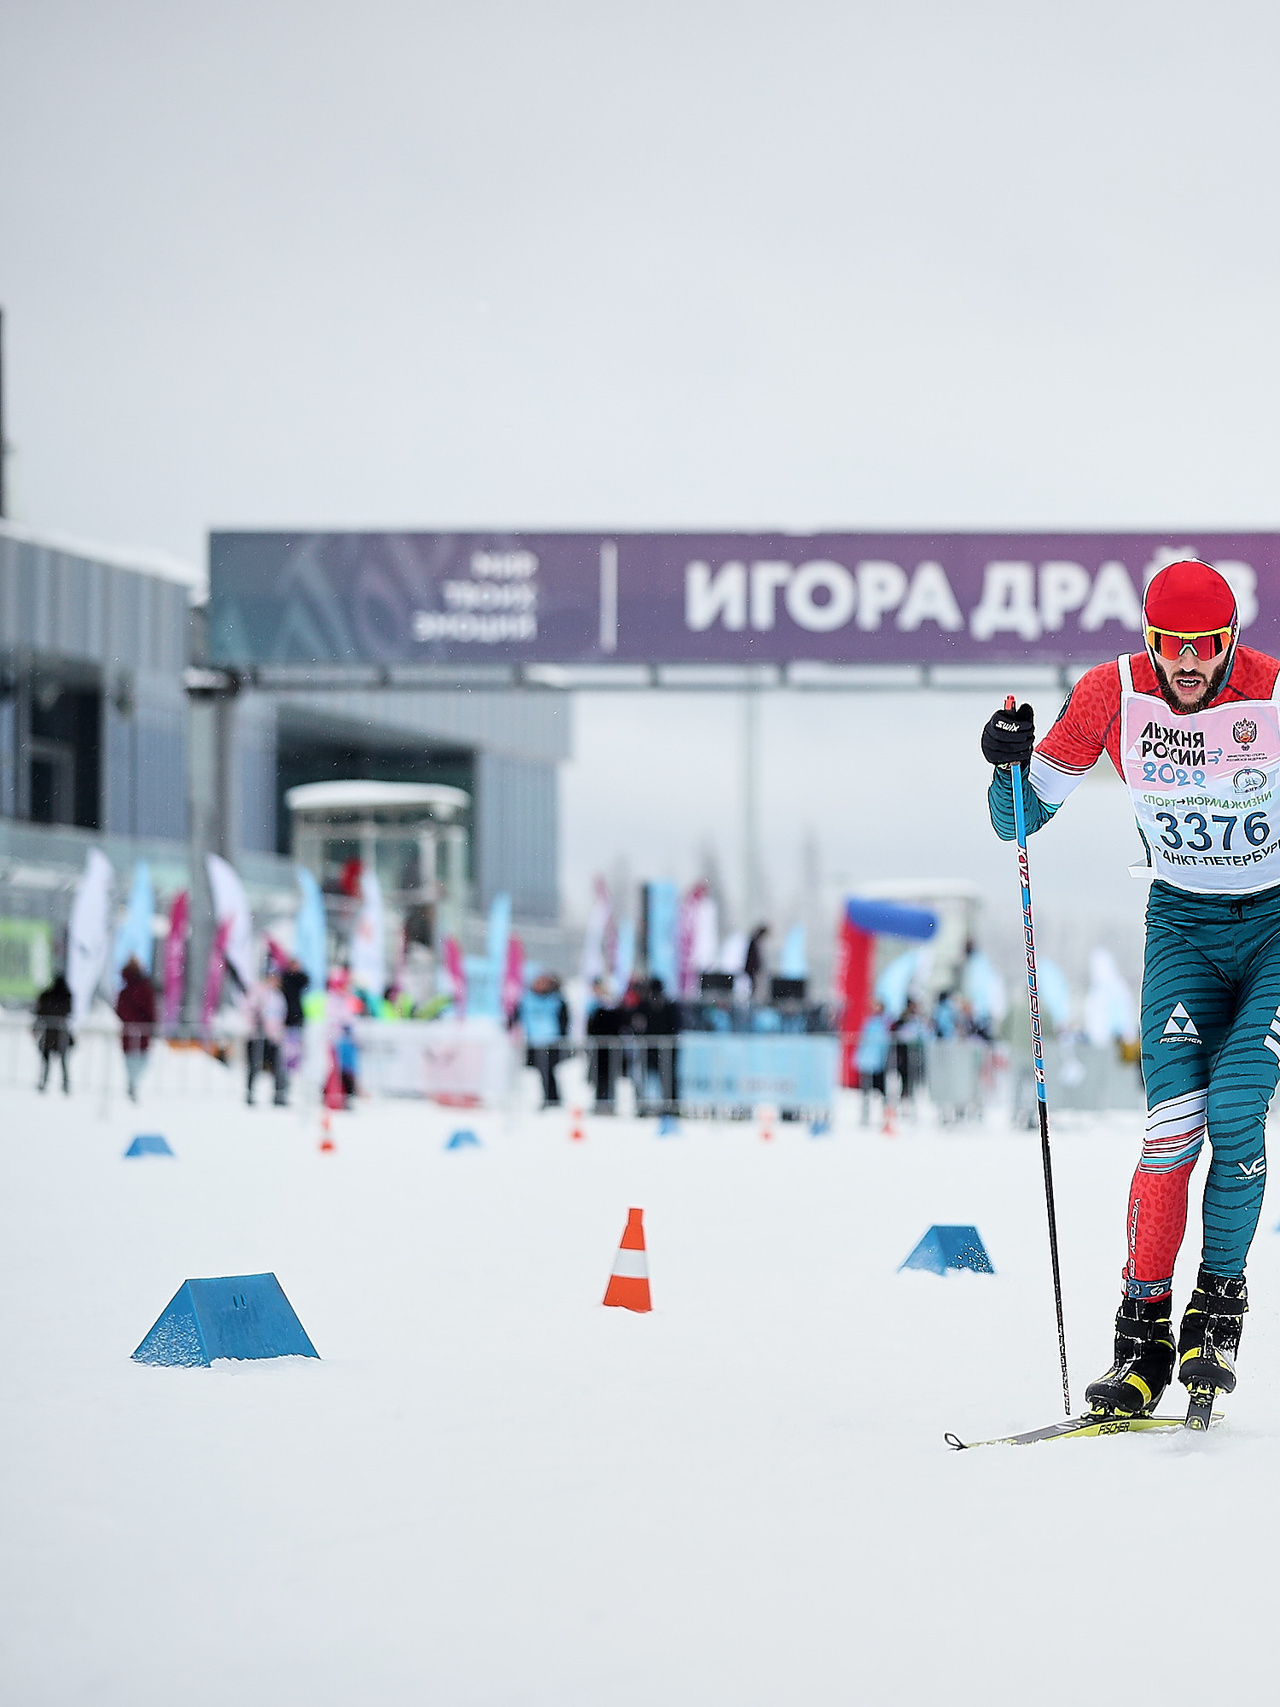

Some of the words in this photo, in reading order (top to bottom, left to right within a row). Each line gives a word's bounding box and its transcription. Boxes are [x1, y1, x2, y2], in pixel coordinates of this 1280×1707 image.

[685, 560, 963, 632] ИГОРА
[971, 547, 1257, 641] ДРА
[1142, 761, 1207, 789] 2022
[1143, 794, 1177, 807] СПОРТ
[1186, 794, 1230, 809] НОРМА
[1230, 790, 1273, 809] ЖИЗНИ
[1155, 811, 1271, 851] 3376
[1159, 1037, 1202, 1045] FISCHER
[1129, 1198, 1141, 1254] VICTORY
[1098, 1421, 1130, 1435] FISCHER
